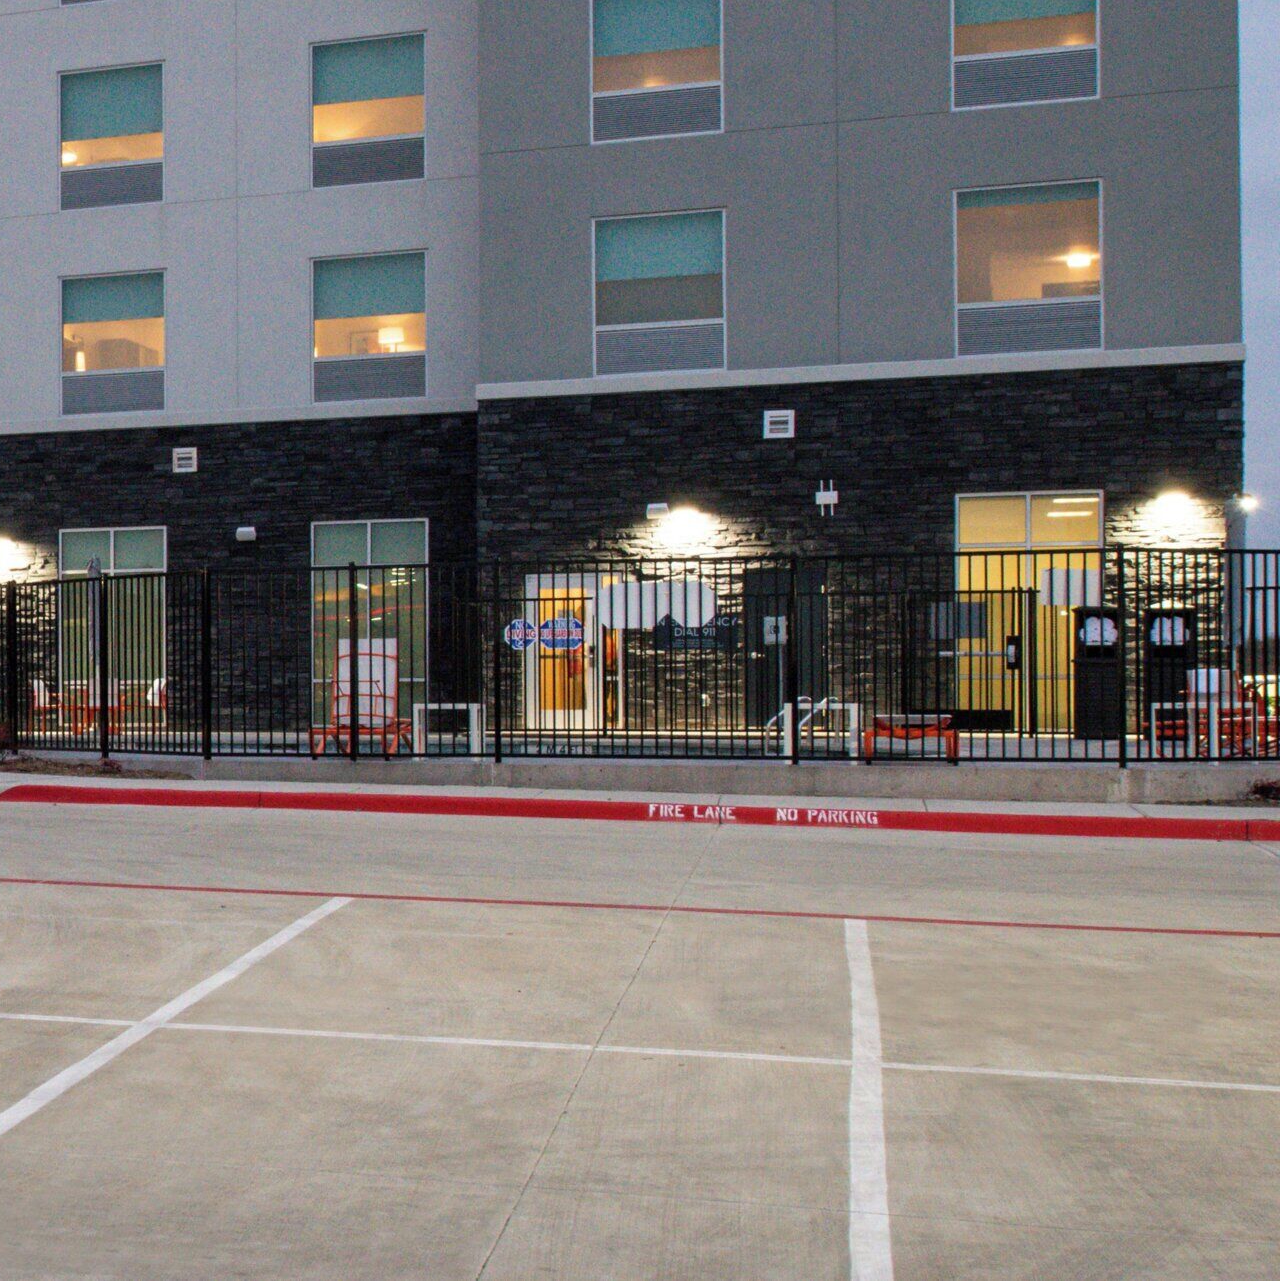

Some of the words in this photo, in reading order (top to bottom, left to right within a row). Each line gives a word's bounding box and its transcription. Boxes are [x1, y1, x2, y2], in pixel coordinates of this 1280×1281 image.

[674, 627, 699, 636] DIAL
[702, 627, 716, 636] 911
[648, 803, 685, 818] FIRE
[693, 805, 736, 820] LANE
[776, 807, 799, 822] NO
[807, 809, 879, 825] PARKING
